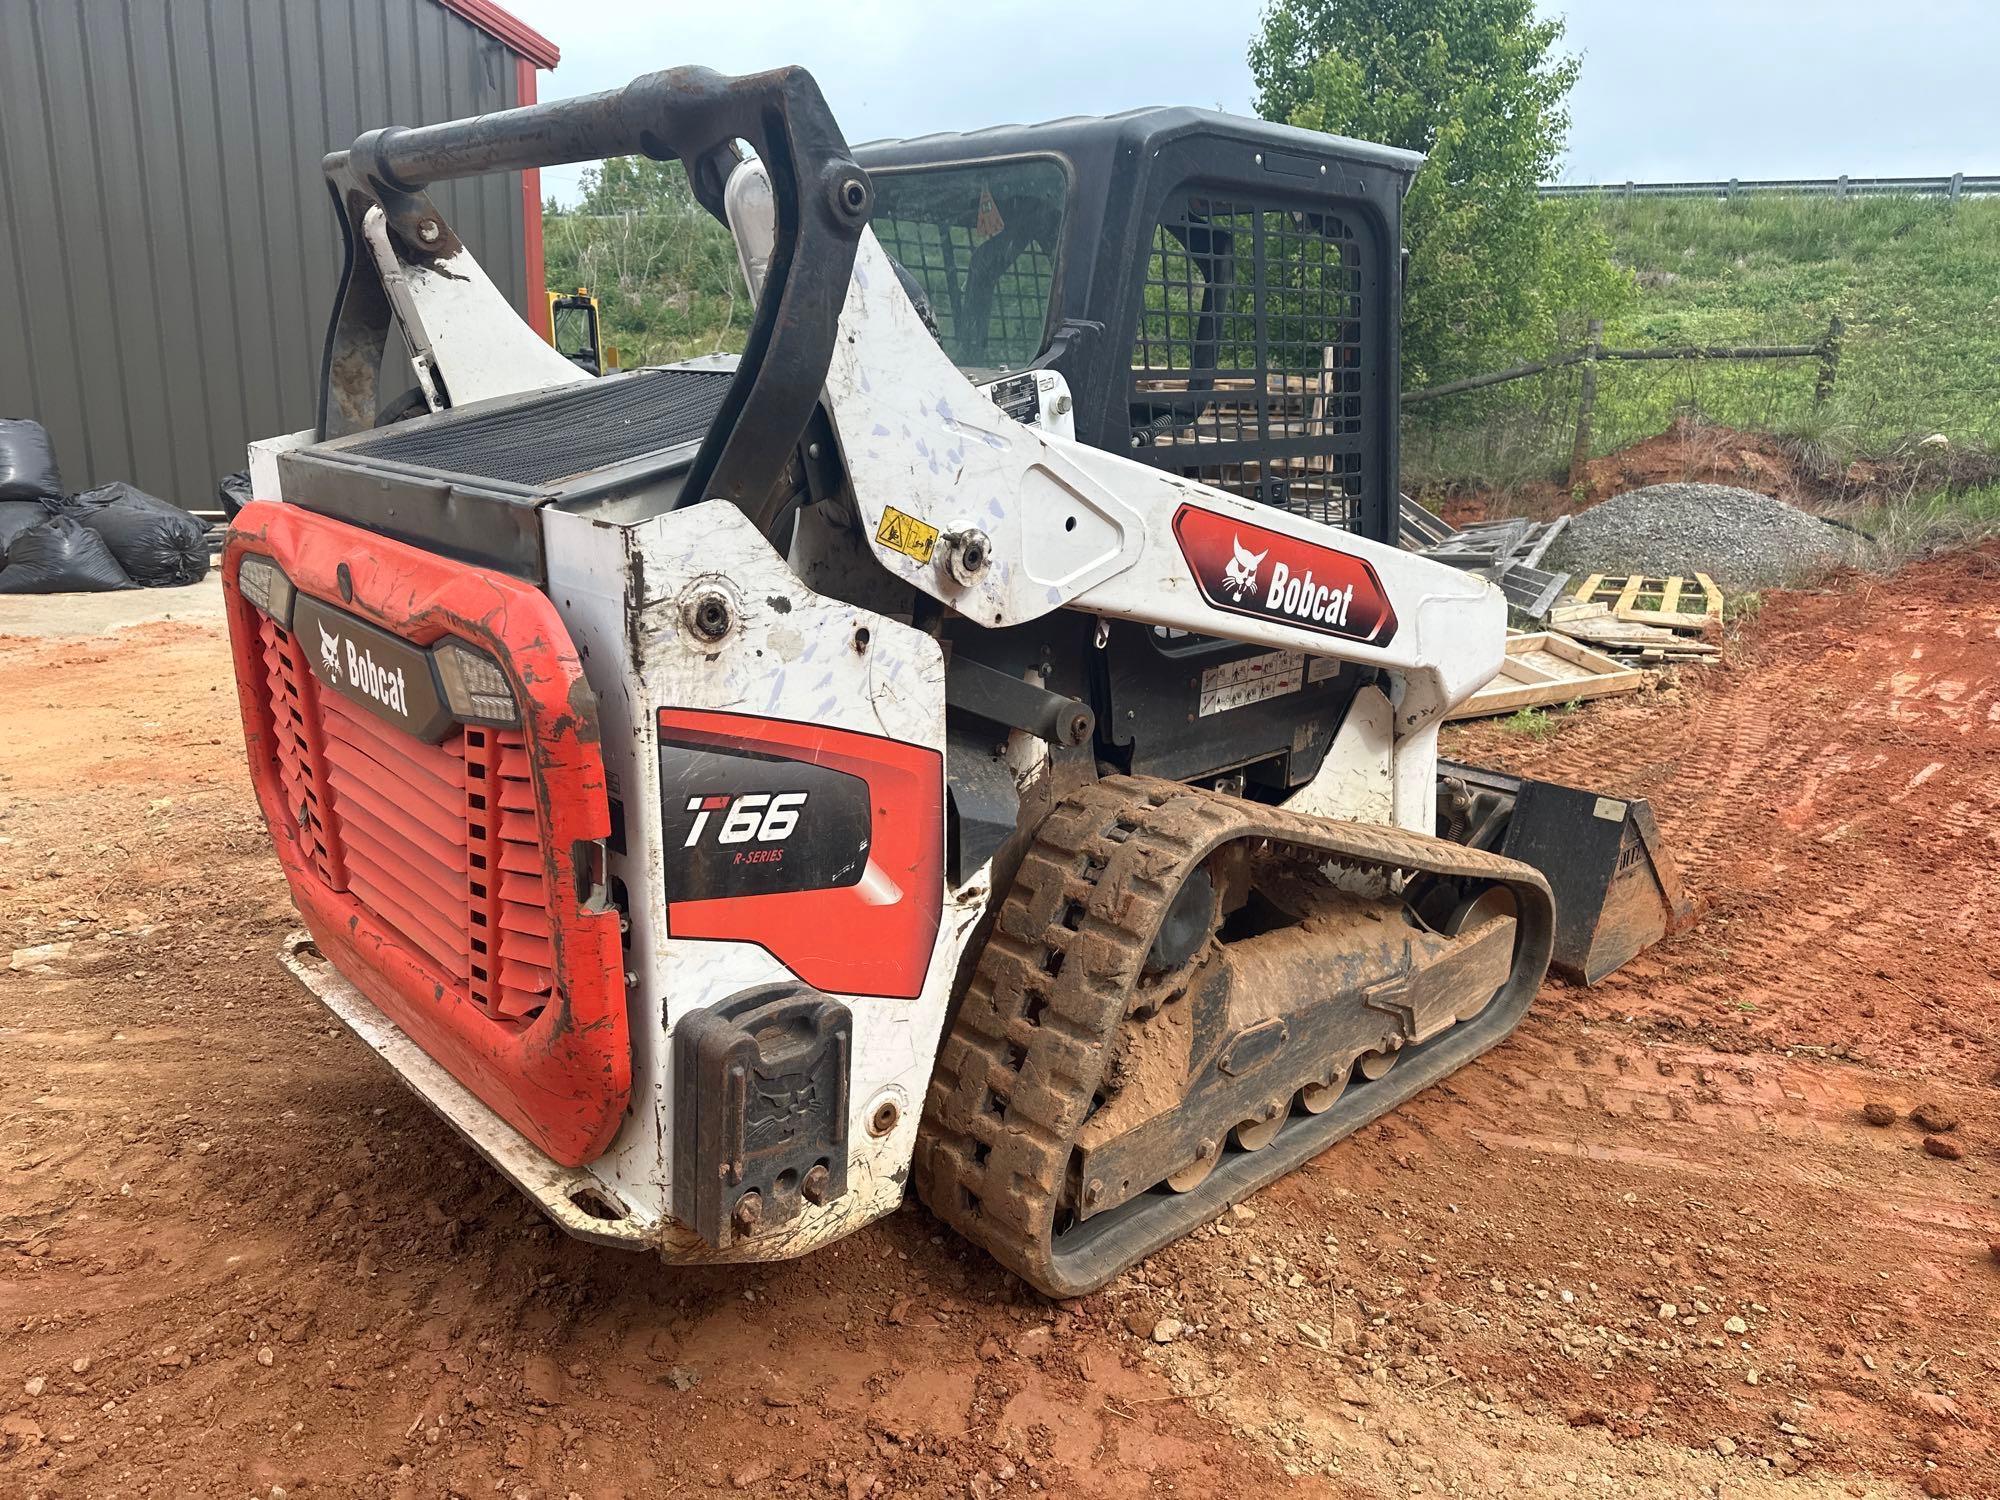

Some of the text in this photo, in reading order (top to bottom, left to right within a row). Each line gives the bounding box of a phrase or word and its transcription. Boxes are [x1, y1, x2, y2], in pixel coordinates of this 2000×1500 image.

[1265, 561, 1354, 627] Bobcat
[345, 638, 408, 717] Bobcat
[684, 792, 808, 847] T66
[733, 849, 784, 865] R-SERIES
